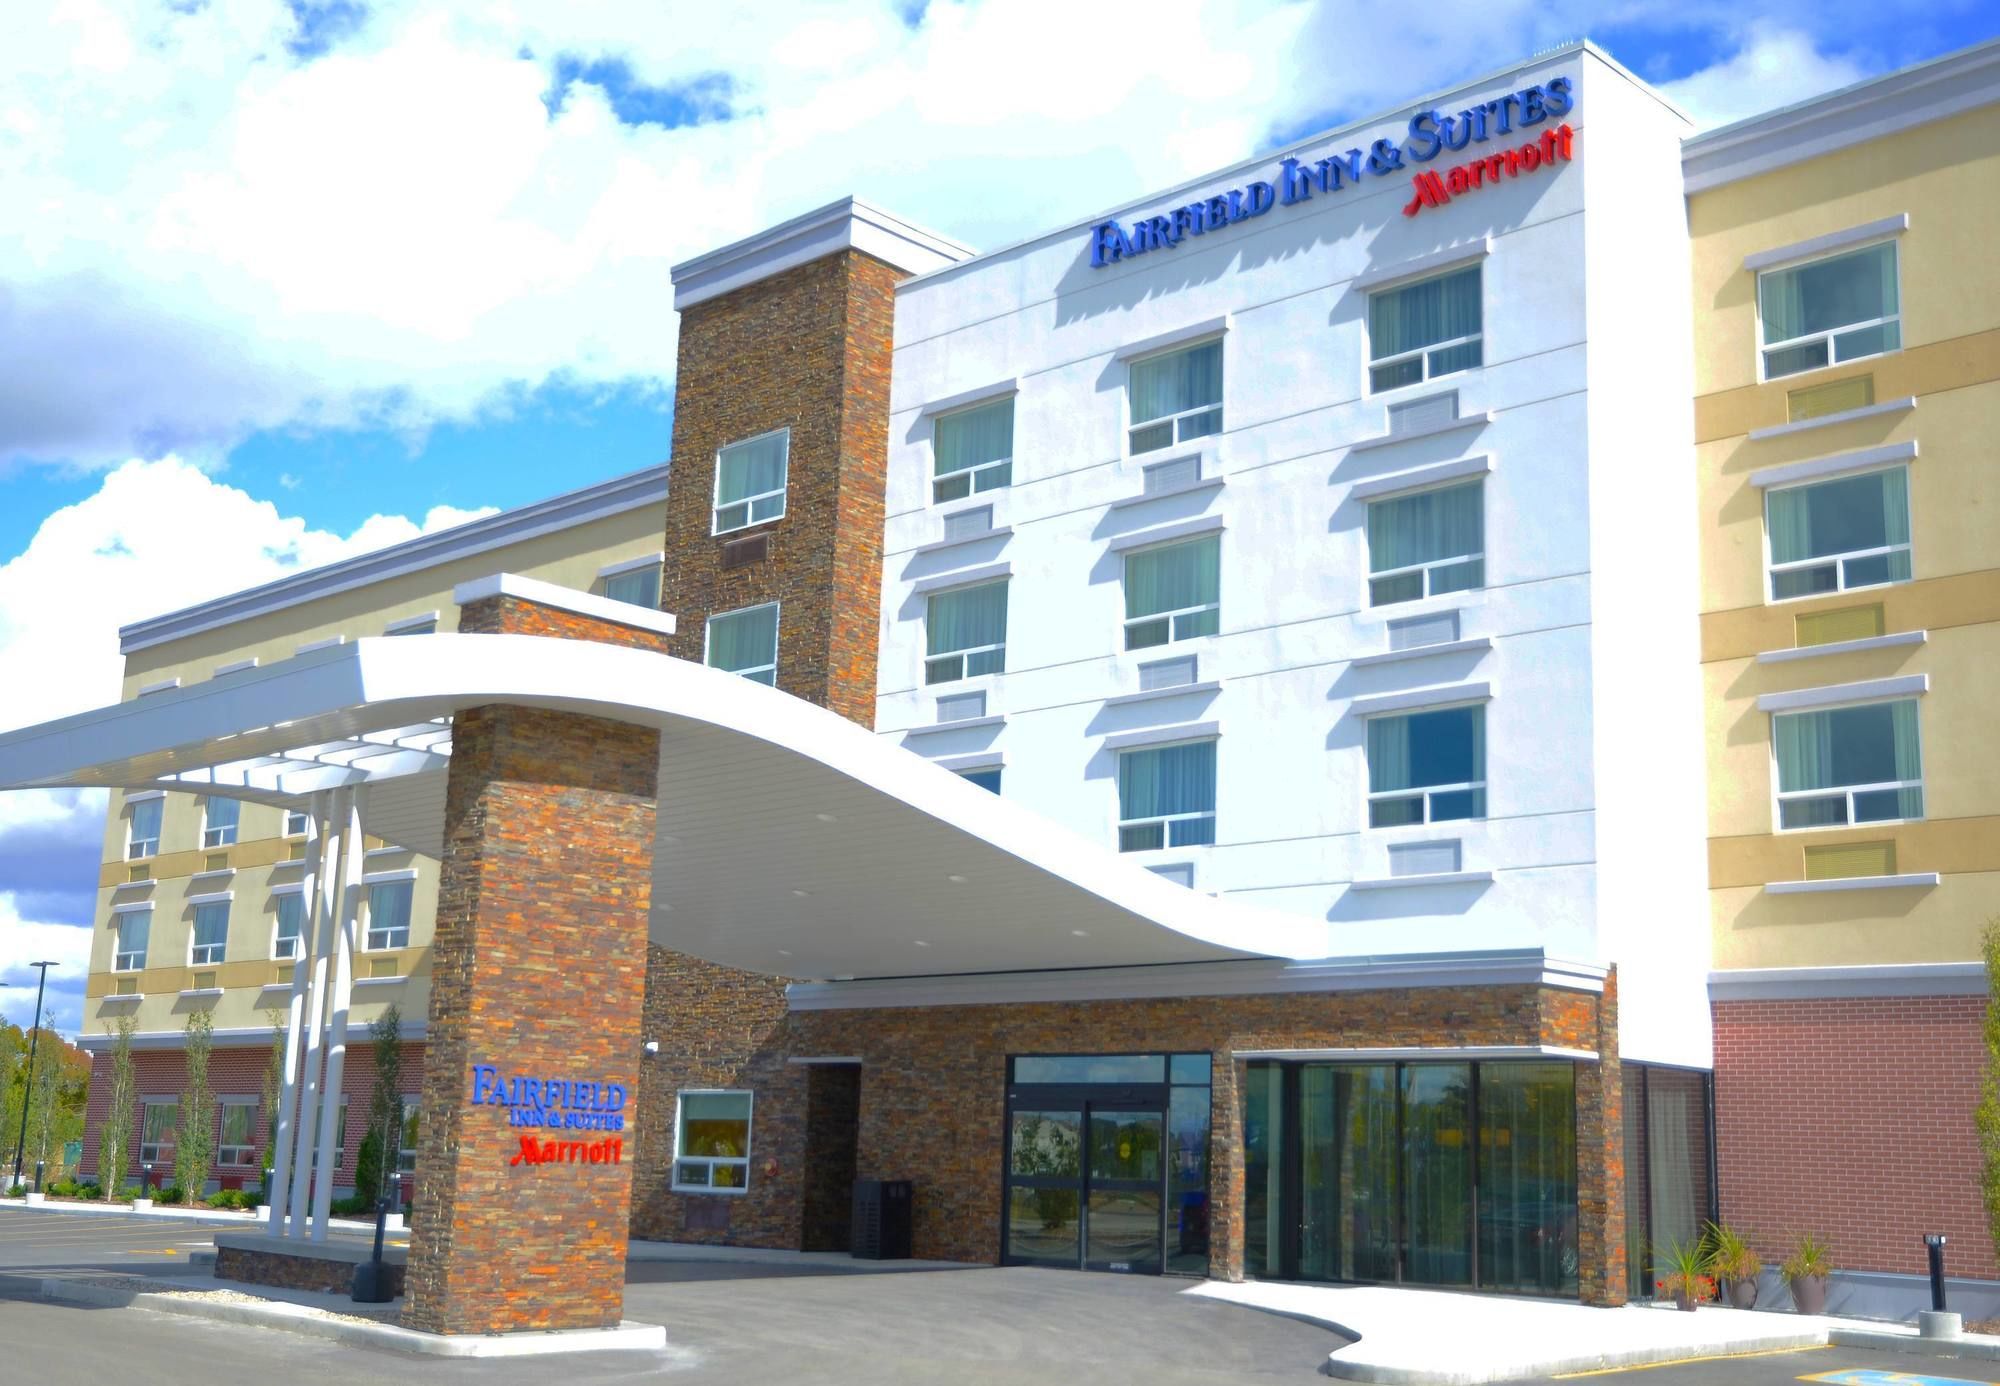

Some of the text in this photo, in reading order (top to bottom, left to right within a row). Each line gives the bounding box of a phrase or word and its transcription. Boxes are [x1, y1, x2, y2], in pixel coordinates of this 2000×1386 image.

[1088, 76, 1574, 268] FAIRFIELD INN & SUITES
[1402, 123, 1575, 217] Marriott
[471, 1064, 627, 1112] FAIRFIELD
[510, 1108, 624, 1131] INN & SUITES
[510, 1134, 623, 1166] Marriott
